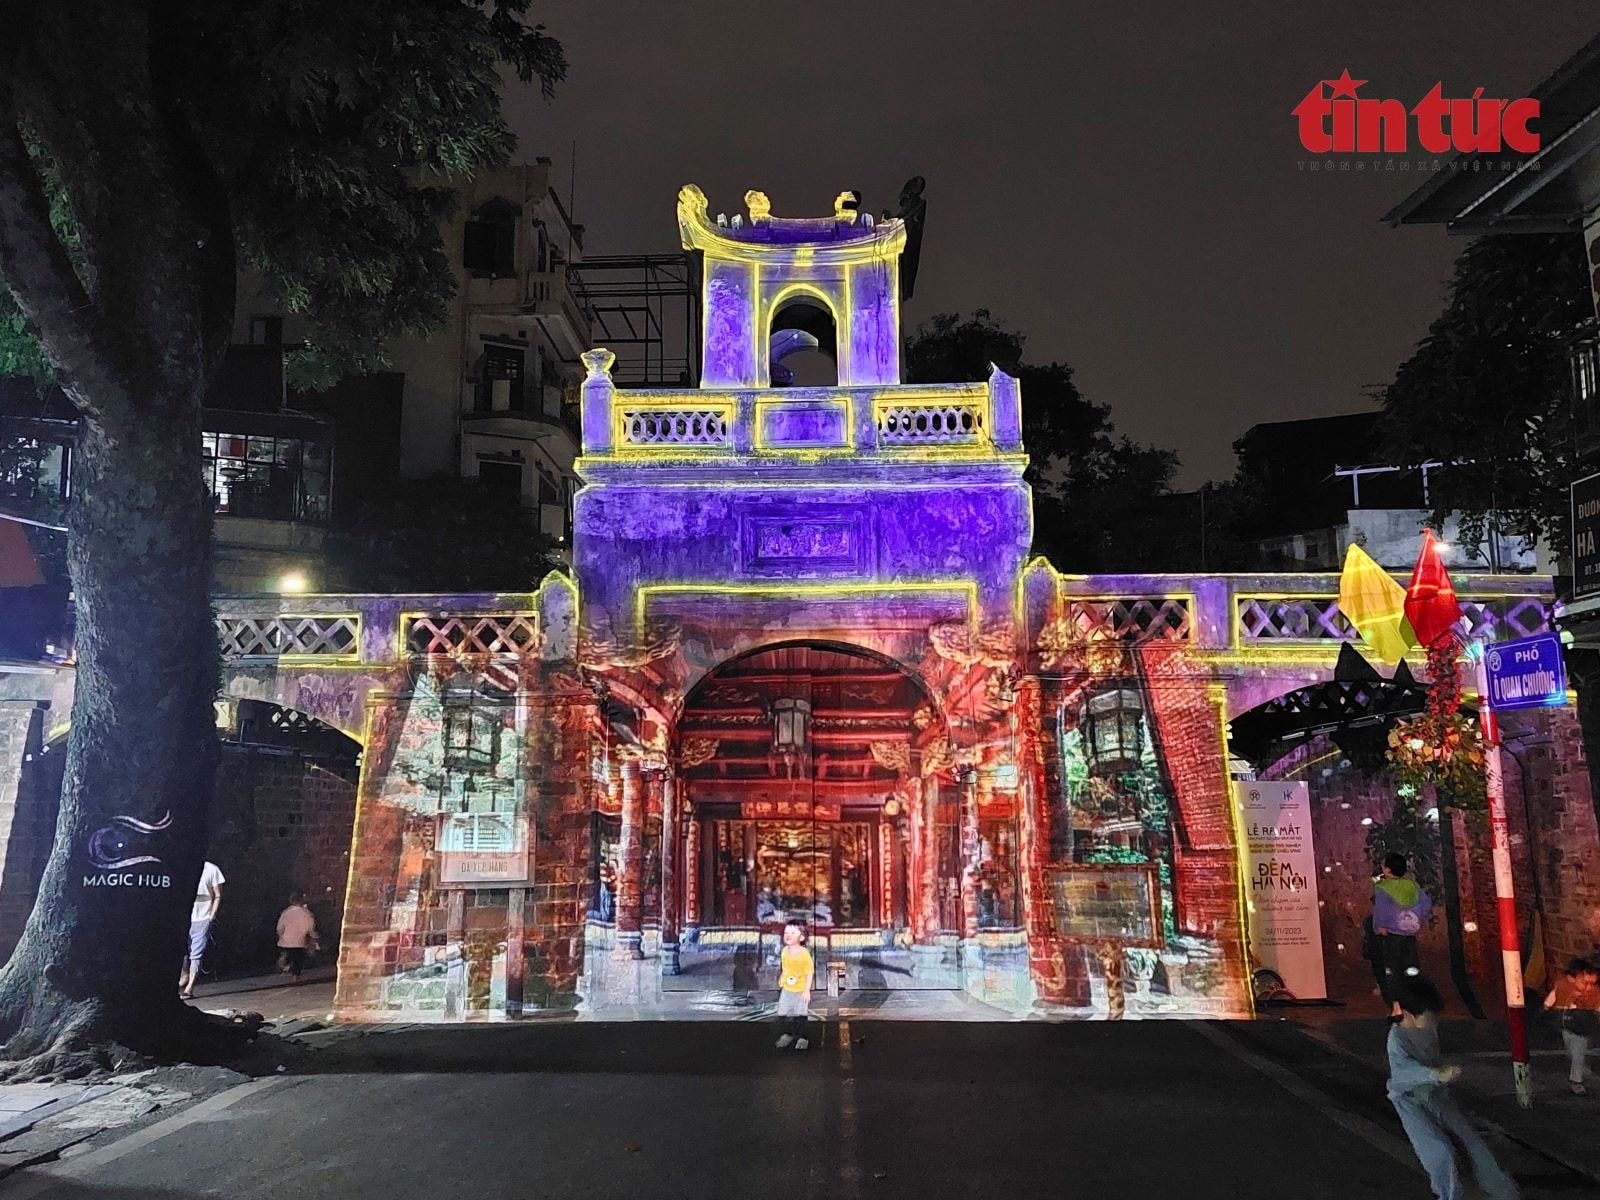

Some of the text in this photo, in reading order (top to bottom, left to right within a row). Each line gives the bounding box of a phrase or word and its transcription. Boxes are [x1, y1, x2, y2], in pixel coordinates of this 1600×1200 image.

[1515, 643, 1539, 663] PHỐ
[1493, 674, 1500, 700] Ô
[1500, 675, 1522, 702] QUAN
[1258, 857, 1293, 876] ĐÊM
[82, 873, 171, 888] MAGIC HUB
[1280, 872, 1307, 893] NỘI
